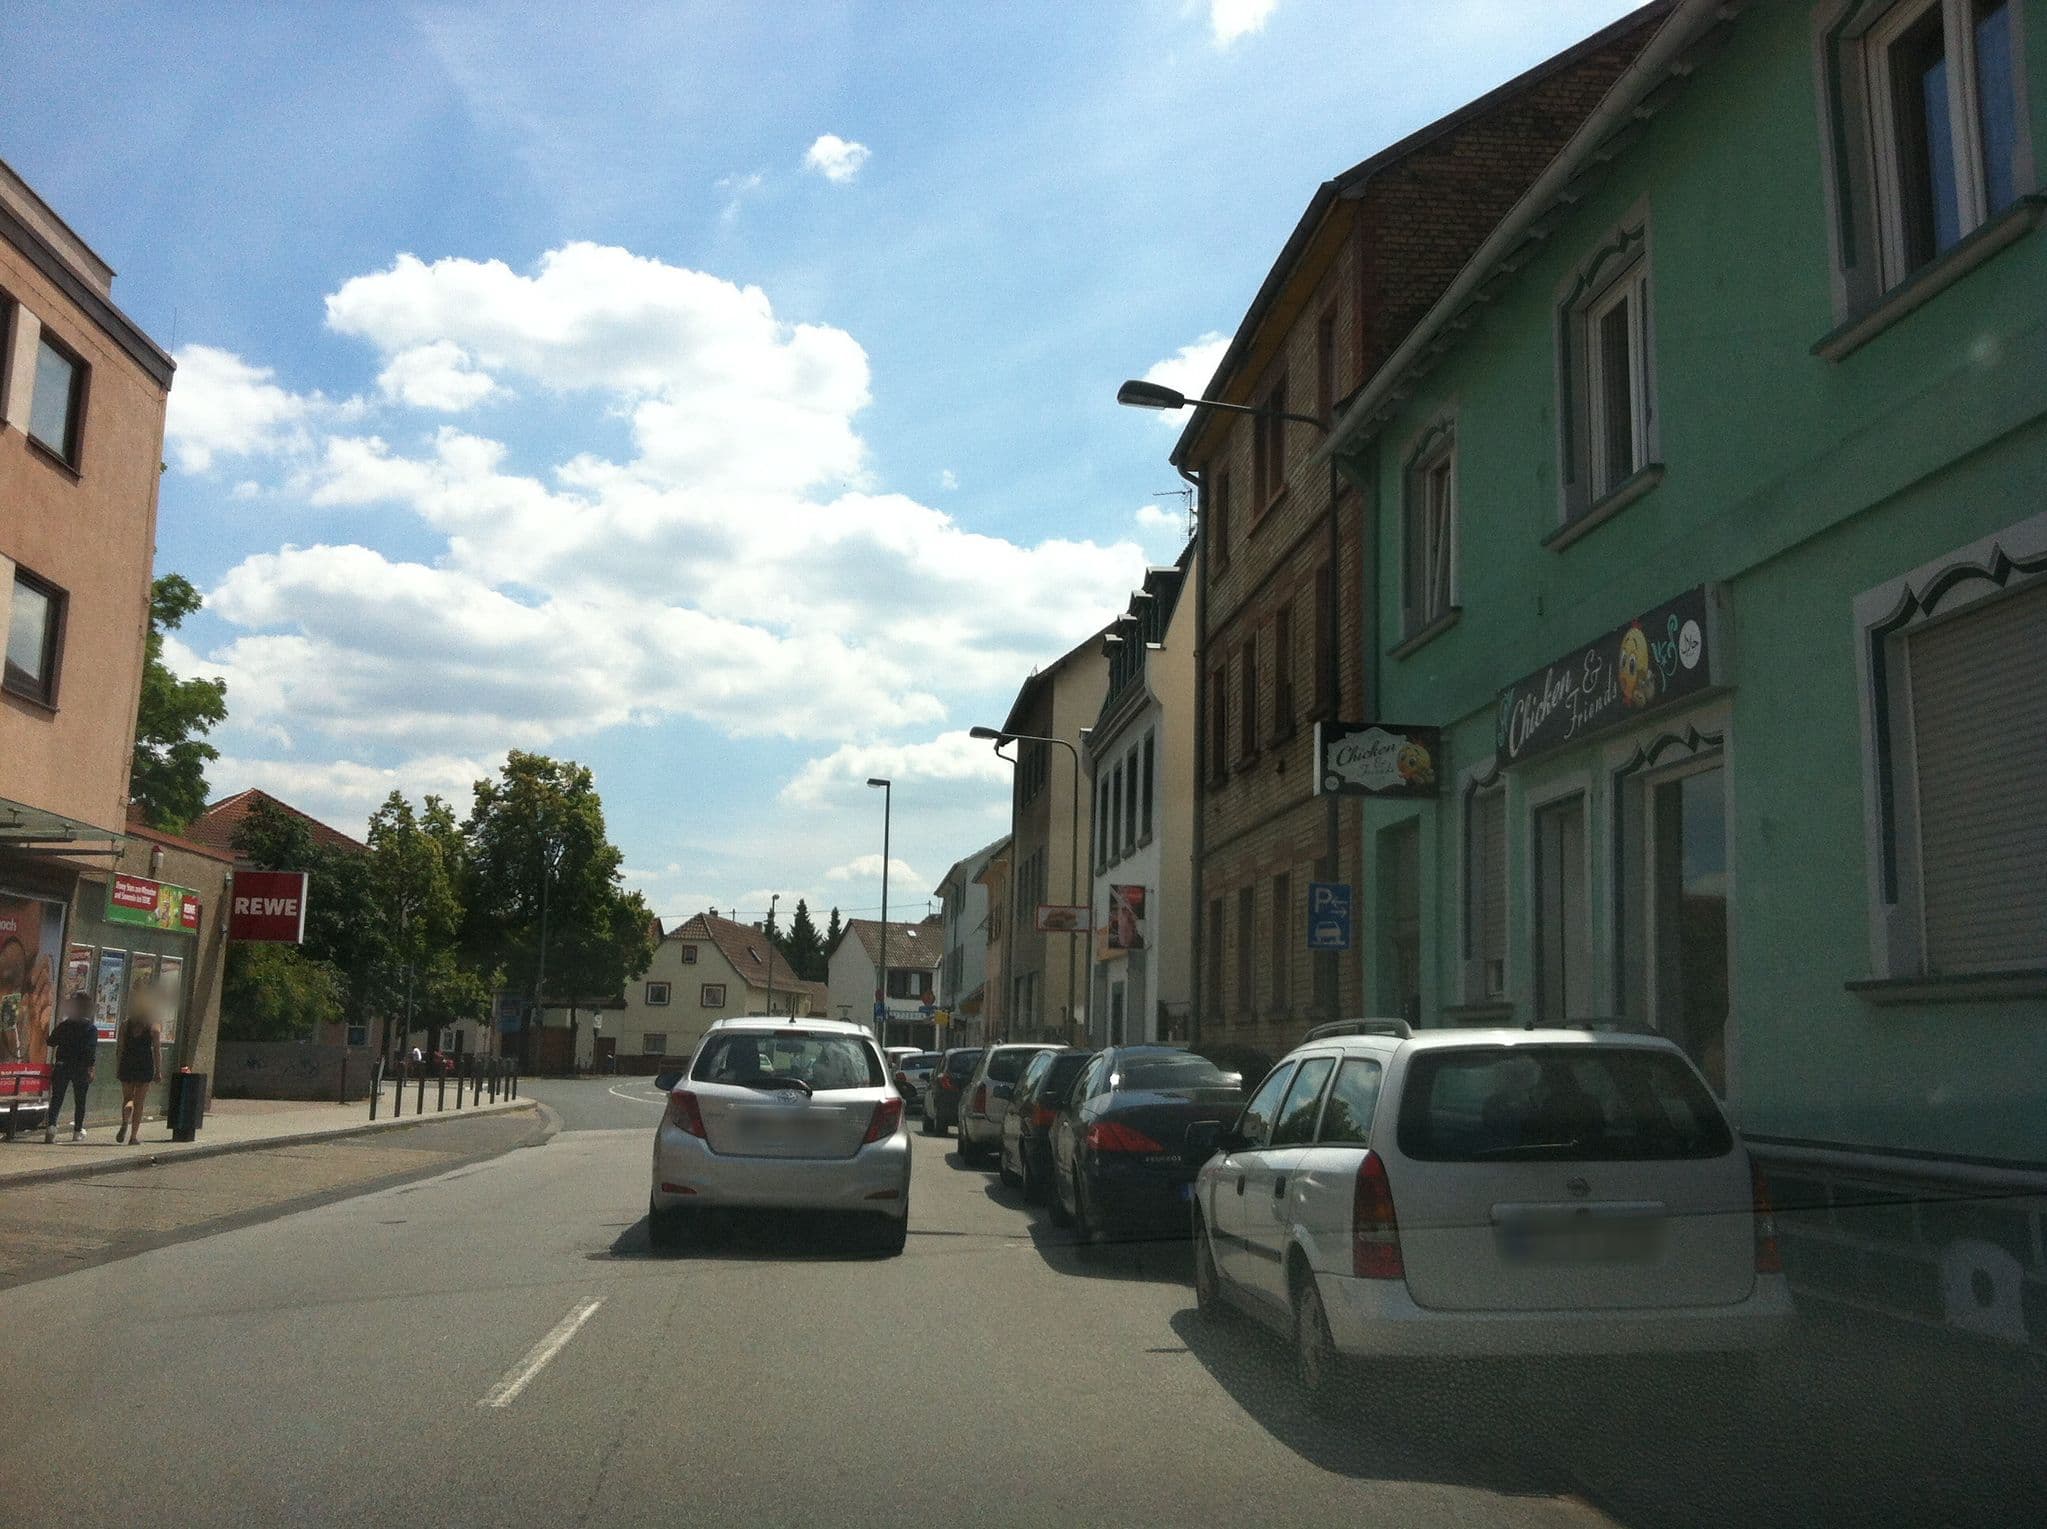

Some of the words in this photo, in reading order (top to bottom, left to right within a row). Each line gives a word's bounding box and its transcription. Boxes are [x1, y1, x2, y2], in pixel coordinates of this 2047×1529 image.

[1509, 667, 1574, 758] Chicken
[1582, 648, 1602, 693] &
[1563, 663, 1618, 739] Friends
[1336, 740, 1397, 767] Chicken
[235, 897, 297, 916] REWE
[1315, 887, 1333, 913] P
